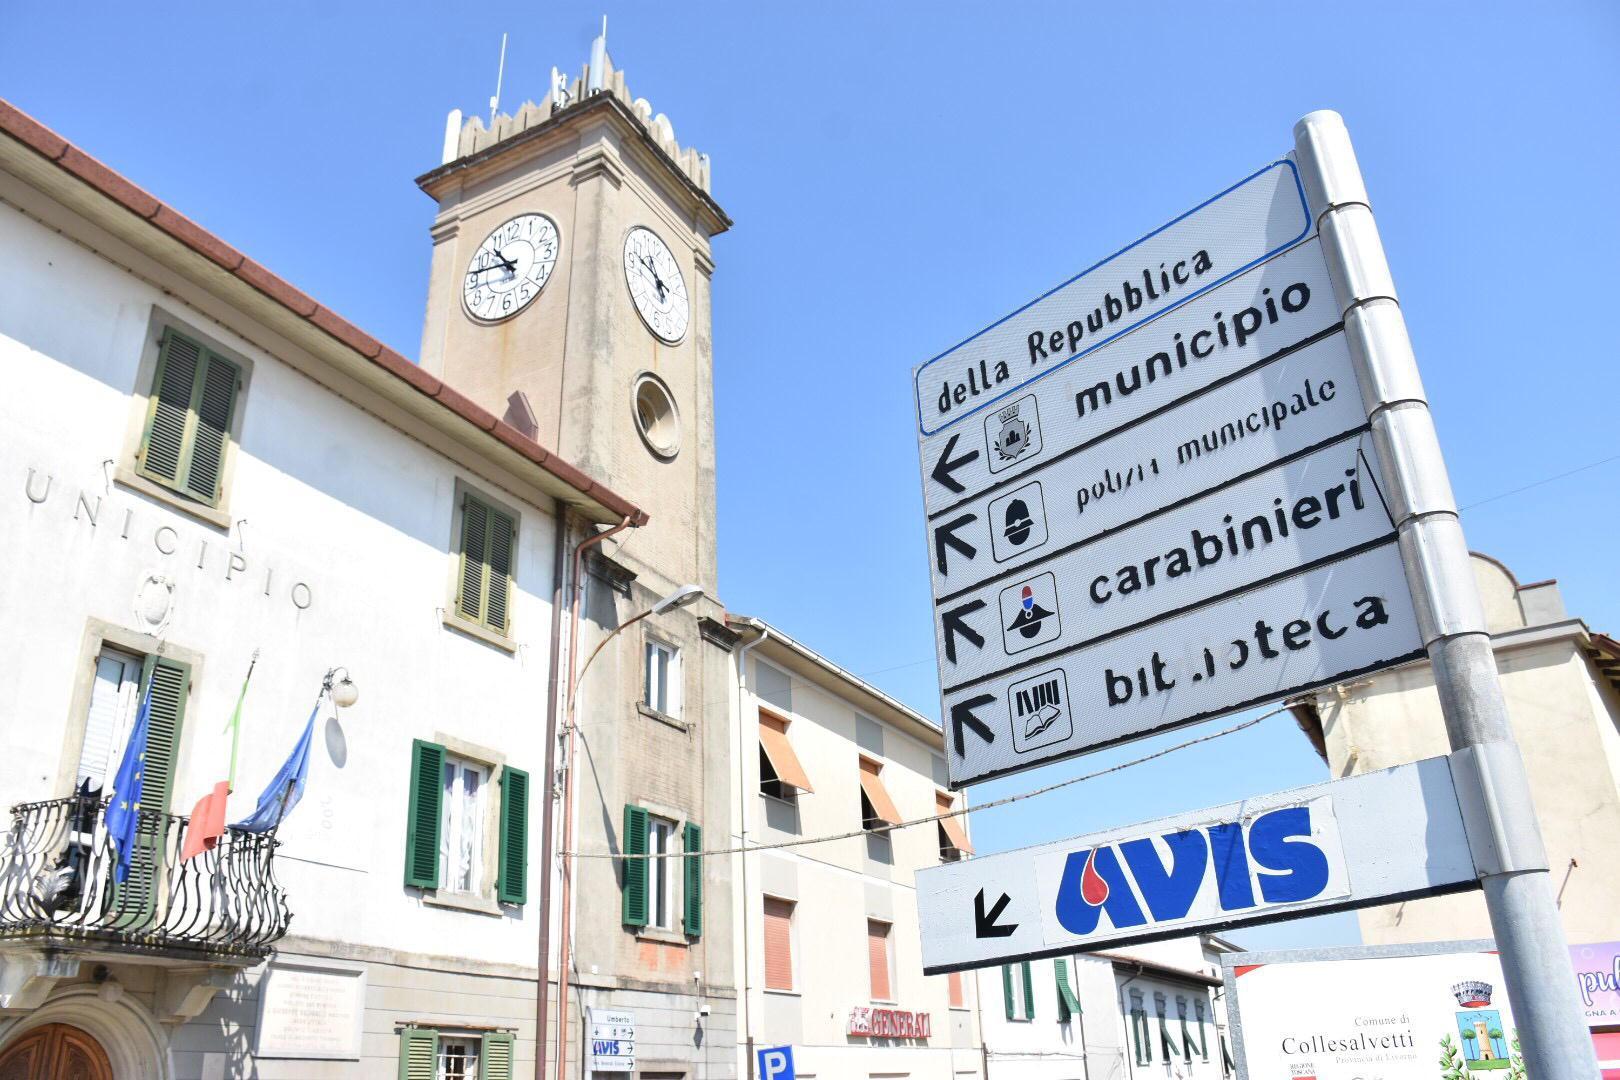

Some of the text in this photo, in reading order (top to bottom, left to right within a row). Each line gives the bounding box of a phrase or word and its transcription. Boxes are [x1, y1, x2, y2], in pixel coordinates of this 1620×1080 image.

[507, 223, 520, 241] 12
[539, 225, 548, 243] 2
[543, 242, 552, 259] 3
[536, 264, 545, 280] 4
[520, 282, 530, 300] 5
[502, 293, 512, 310] 6
[938, 249, 1213, 414] della Repubblica
[1074, 282, 1311, 417] municipio
[1089, 468, 1365, 604] carabinieri
[1055, 807, 1330, 936] AVIS
[1354, 1013, 1410, 1026] Comune di
[593, 1040, 620, 1056] AVIS
[1282, 1029, 1414, 1055] Collesalvetti
[764, 1051, 787, 1080] P
